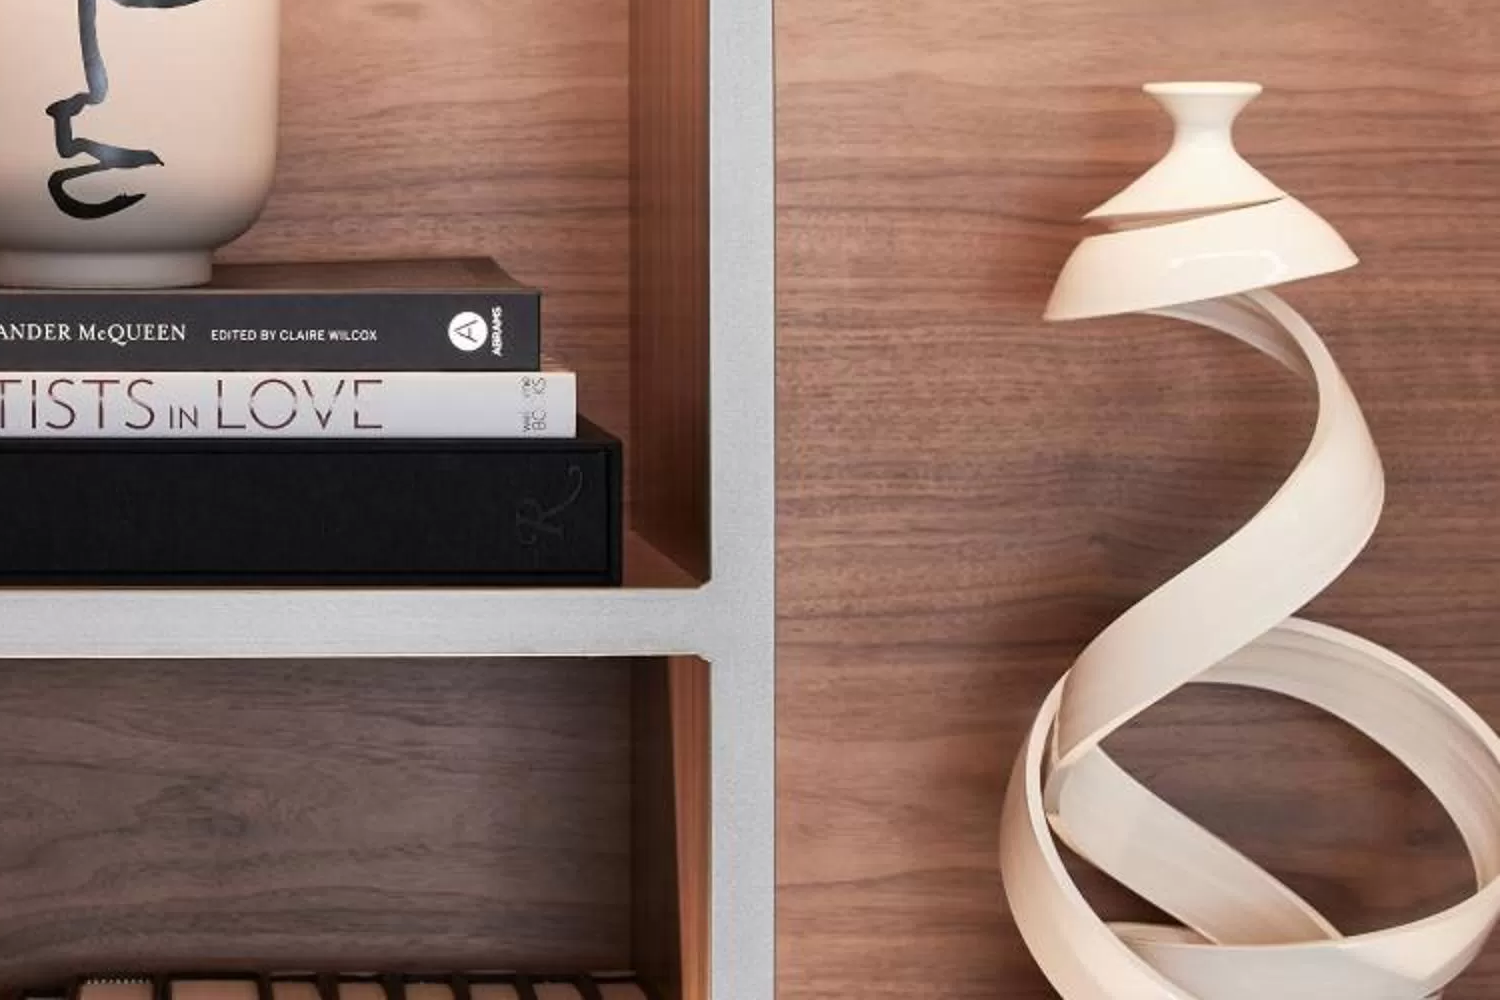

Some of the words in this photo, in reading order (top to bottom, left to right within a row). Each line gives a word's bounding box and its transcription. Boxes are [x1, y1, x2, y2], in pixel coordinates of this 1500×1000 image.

[79, 323, 187, 345] McQUEEN
[211, 329, 256, 341] EDITED
[260, 329, 276, 341] BY
[280, 329, 325, 341] CLAIRE
[329, 329, 378, 341] WILCOX
[491, 305, 503, 357] ABRAMS
[169, 405, 198, 430] IN
[217, 379, 383, 429] LOVE
